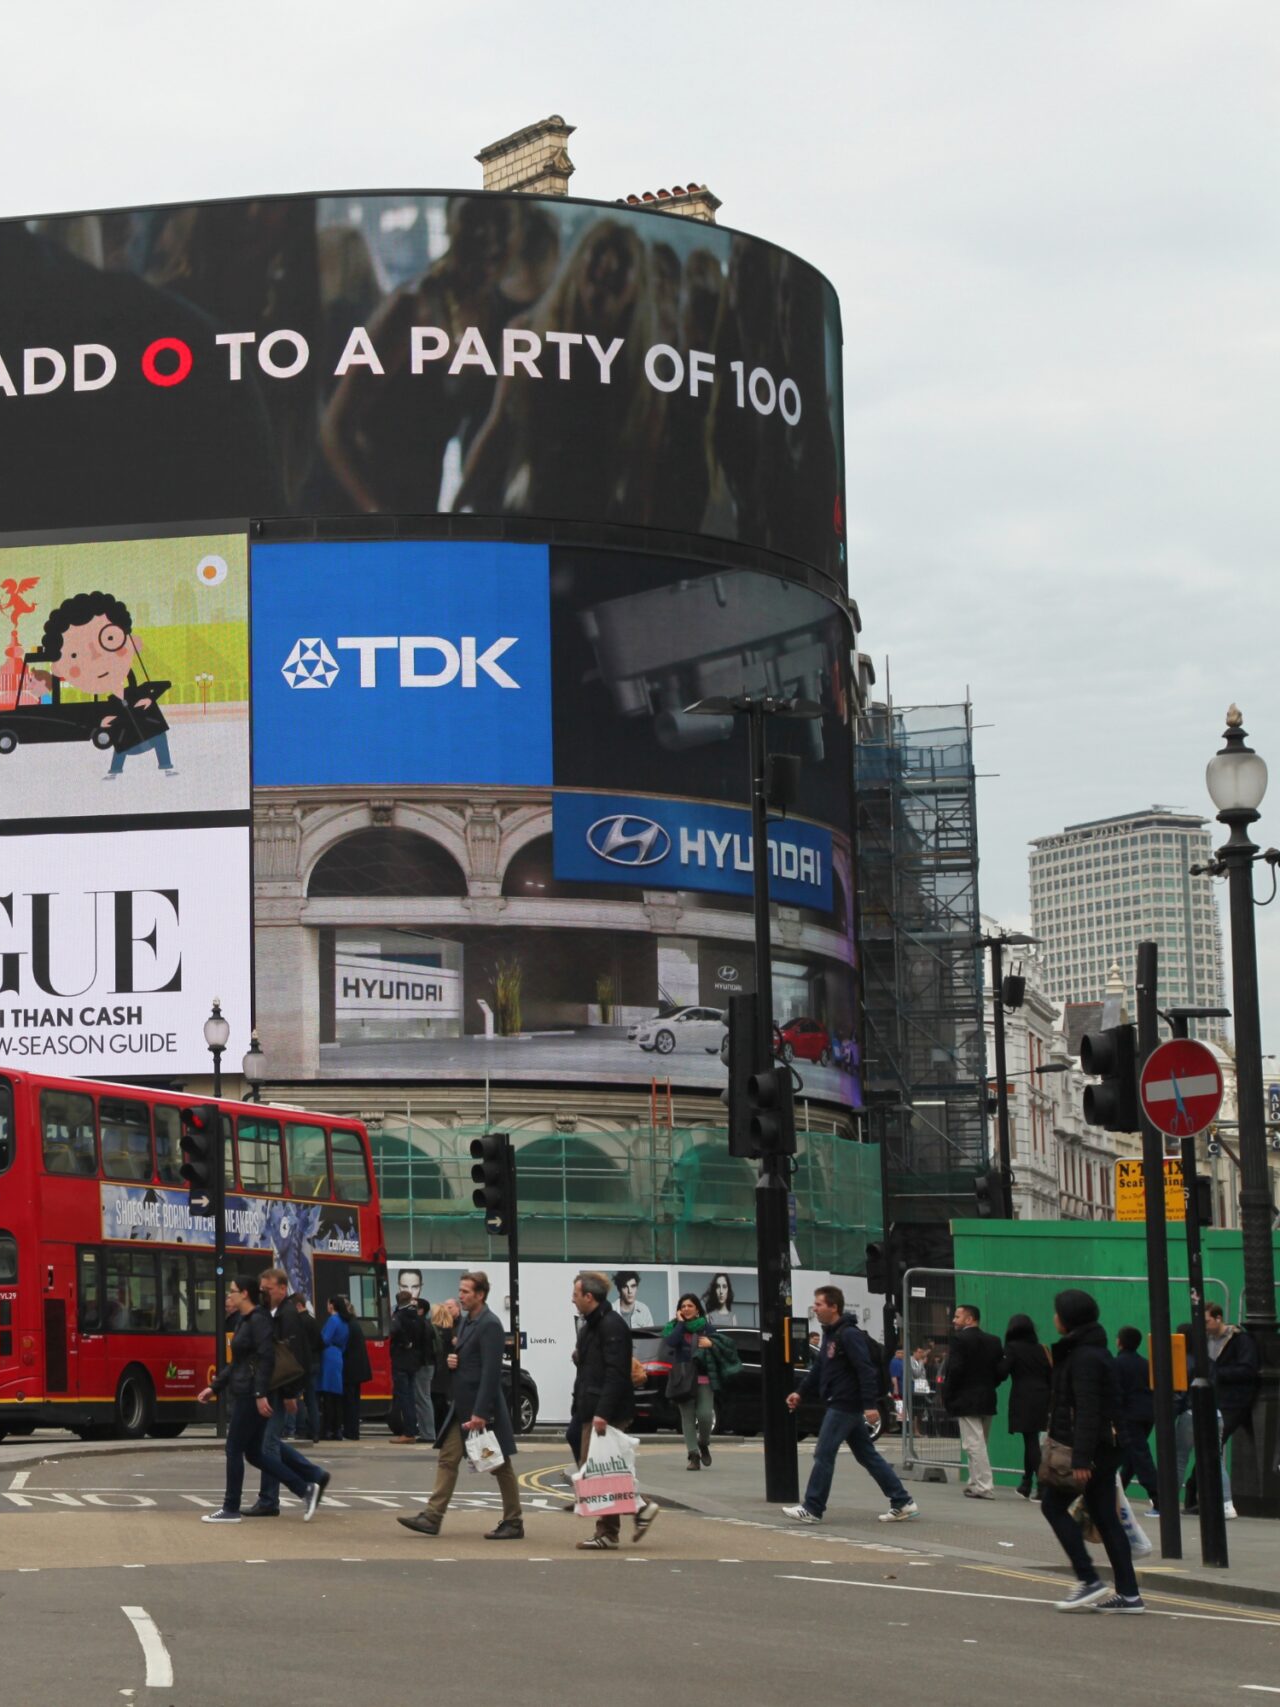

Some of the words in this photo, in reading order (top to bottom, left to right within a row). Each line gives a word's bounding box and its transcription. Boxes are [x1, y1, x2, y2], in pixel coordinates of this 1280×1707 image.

[215, 329, 310, 381] TO
[333, 326, 385, 376] A
[410, 326, 624, 384] PARTY
[644, 343, 716, 397] OF
[730, 360, 802, 426] 100
[337, 636, 521, 689] TDK
[343, 977, 442, 1001] HYUNDAI
[714, 982, 743, 992] HYUNDAI
[11, 1007, 73, 1028] THAN
[79, 1006, 142, 1026] CASH
[109, 1032, 177, 1054] GUIDE
[115, 1200, 142, 1225] SHOES
[144, 1201, 161, 1227] ARE
[162, 1203, 192, 1229] BORING
[224, 1208, 260, 1235] NEAKERS
[328, 1239, 360, 1251] CONVERSE
[1, 1492, 158, 1507] NO
[609, 1491, 634, 1502] DIREC
